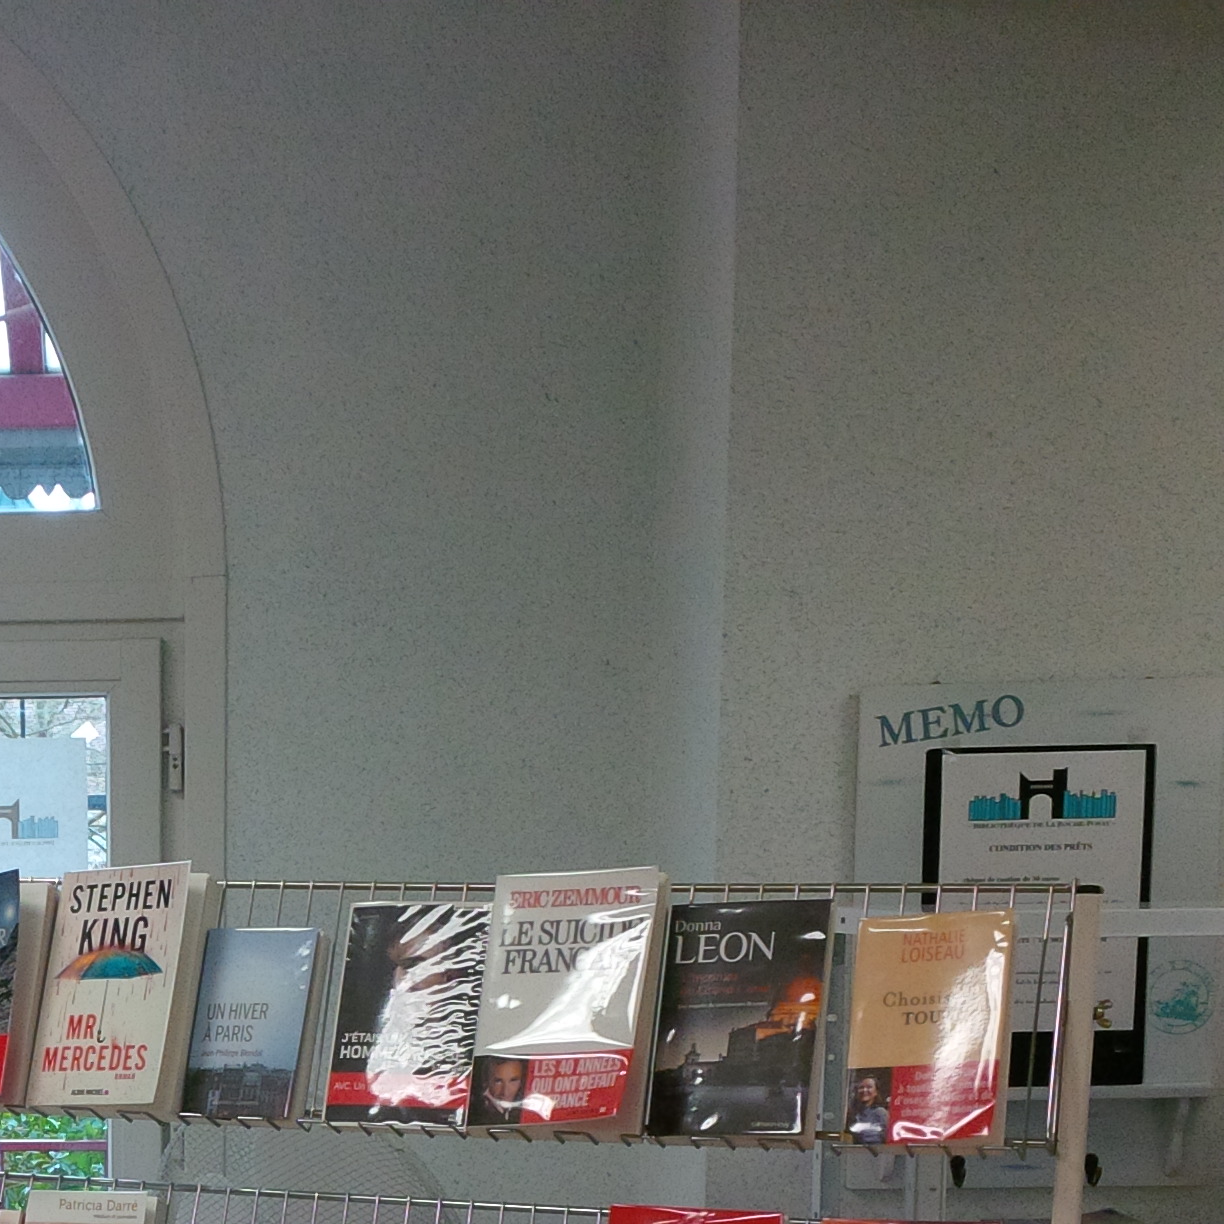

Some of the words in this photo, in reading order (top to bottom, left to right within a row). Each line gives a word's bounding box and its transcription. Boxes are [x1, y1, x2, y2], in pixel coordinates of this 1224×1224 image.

[877, 694, 1025, 747] MEMO
[70, 878, 172, 914] STEPHEN
[78, 915, 148, 955] KING
[676, 919, 721, 933] Donna
[903, 929, 965, 946] NATHALIE
[676, 931, 776, 965] LEON
[900, 944, 964, 962] LOISEAU
[207, 1004, 225, 1020] UN
[228, 1002, 268, 1020] HIVER
[66, 1014, 96, 1041] MR
[203, 1021, 212, 1041] À
[215, 1024, 253, 1042] PARIS
[42, 1044, 148, 1072] MERCEDES
[534, 1059, 556, 1076] LES
[558, 1059, 574, 1074] 40
[531, 1078, 552, 1093] QUI
[554, 1075, 578, 1092] ONT
[59, 1198, 103, 1212] Patricia
[106, 1199, 138, 1213] Darré
